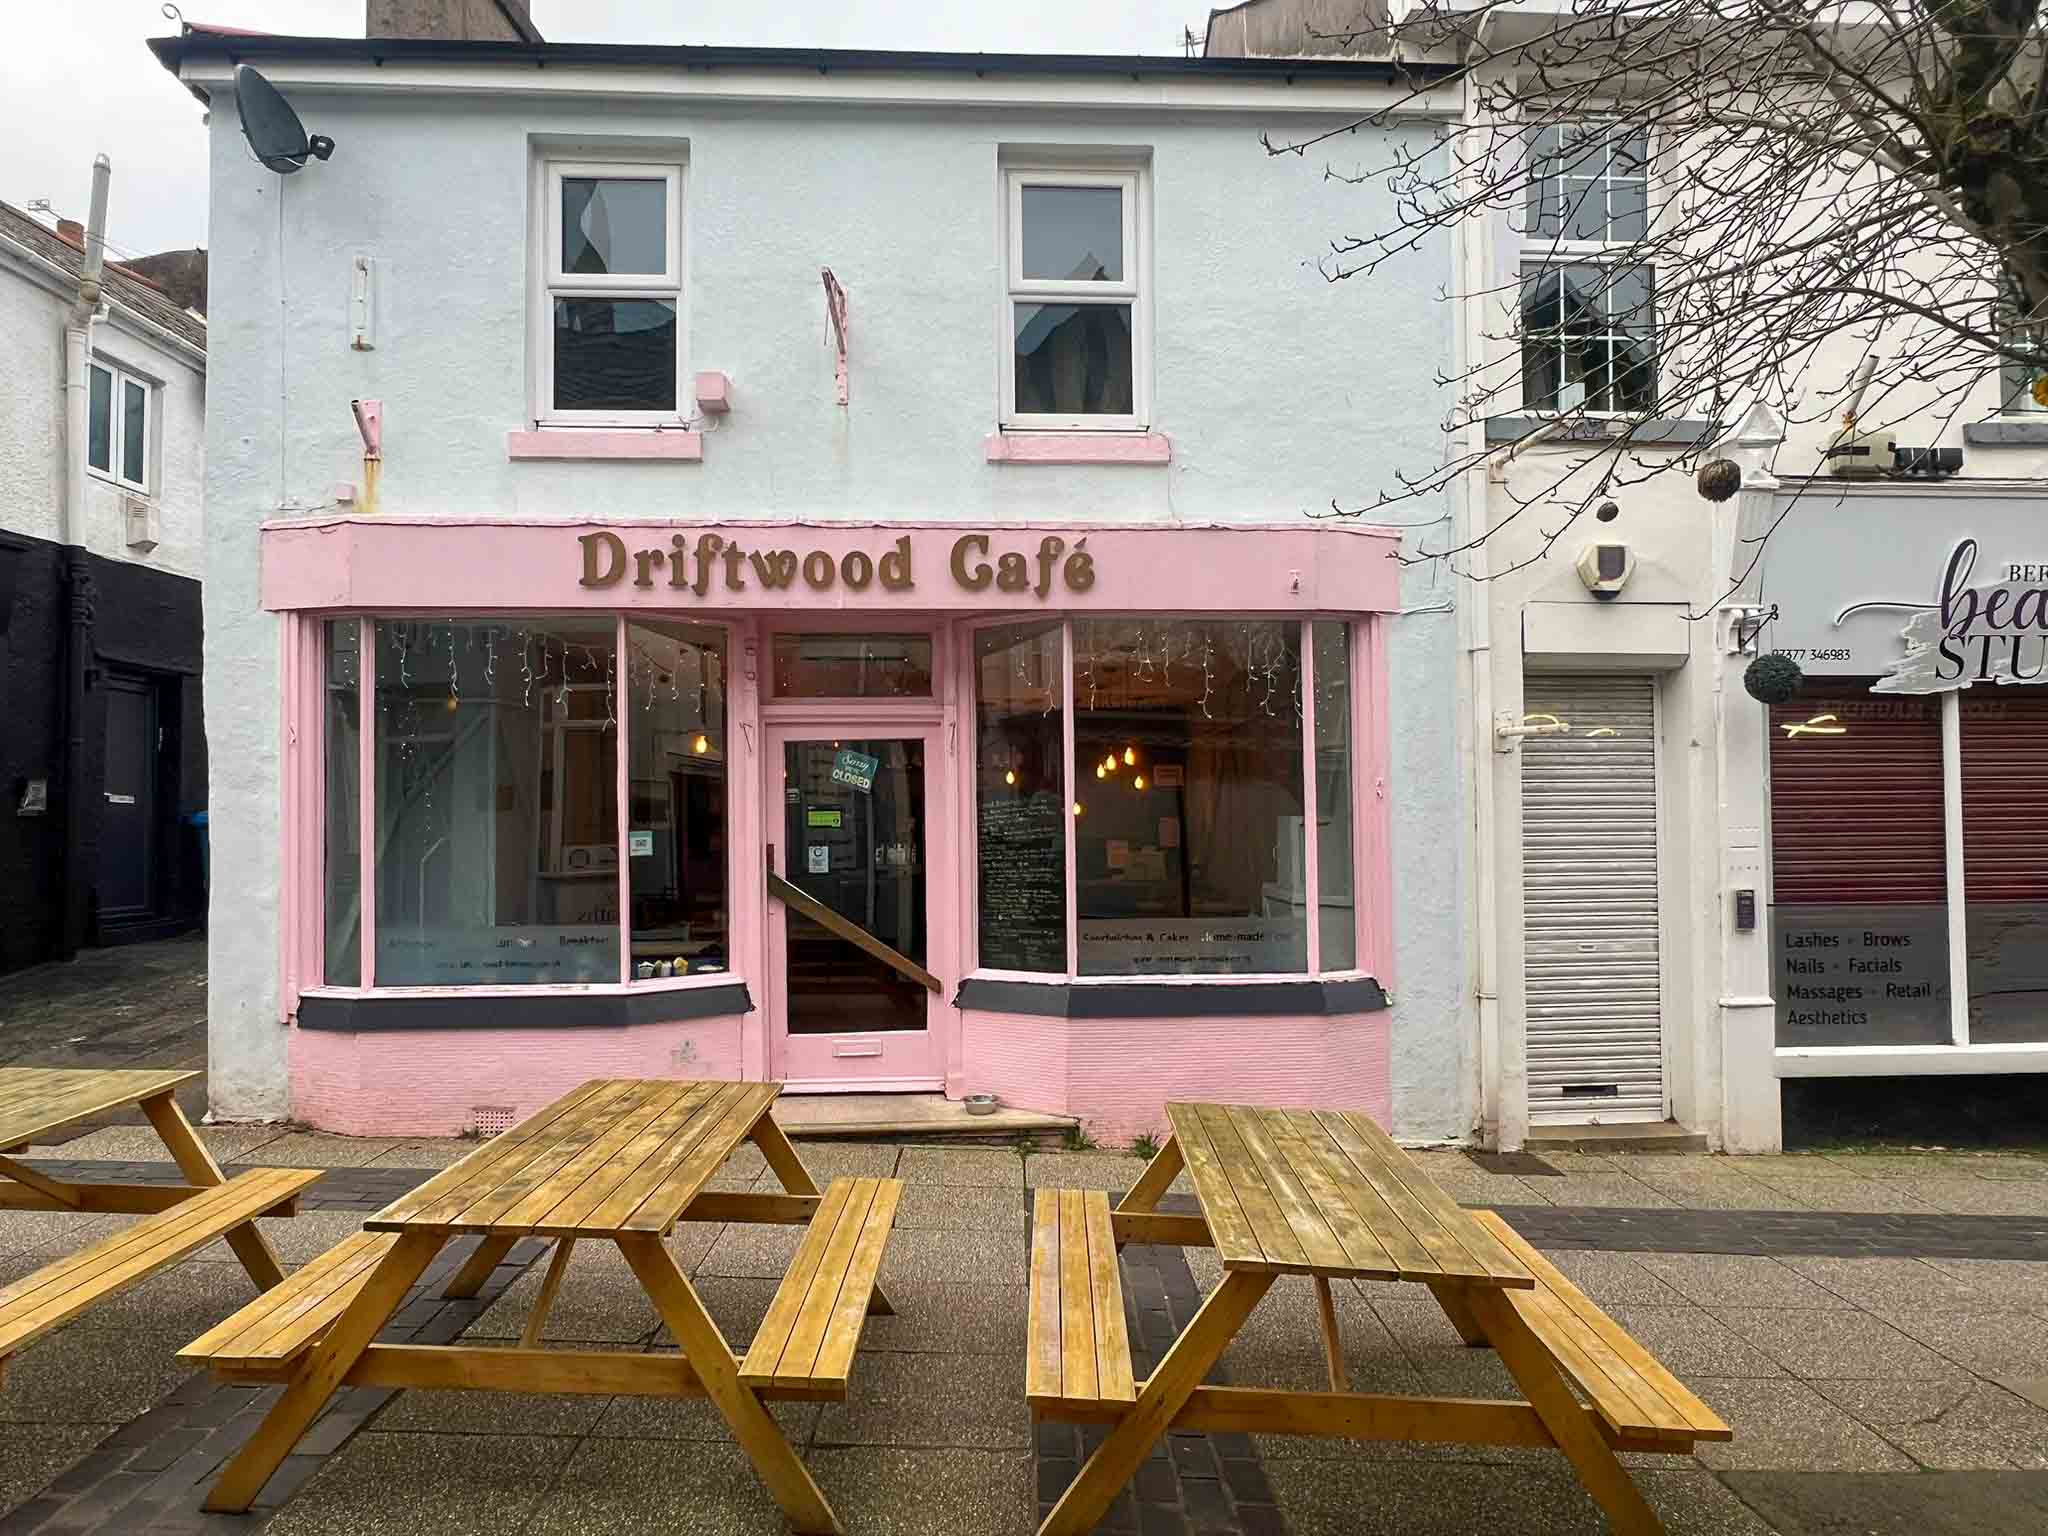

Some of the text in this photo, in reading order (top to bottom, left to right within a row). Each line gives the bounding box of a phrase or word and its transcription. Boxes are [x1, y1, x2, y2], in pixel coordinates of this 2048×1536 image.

[578, 531, 1095, 599] Driftwood Café
[1809, 648, 1850, 661] 346983
[832, 768, 870, 789] CLOSED
[1786, 931, 1911, 948] Lashes Brows
[1786, 957, 1903, 974] Nails Facials
[1787, 982, 1930, 1002] Massages Retail
[1787, 1008, 1868, 1025] Aesthetics
